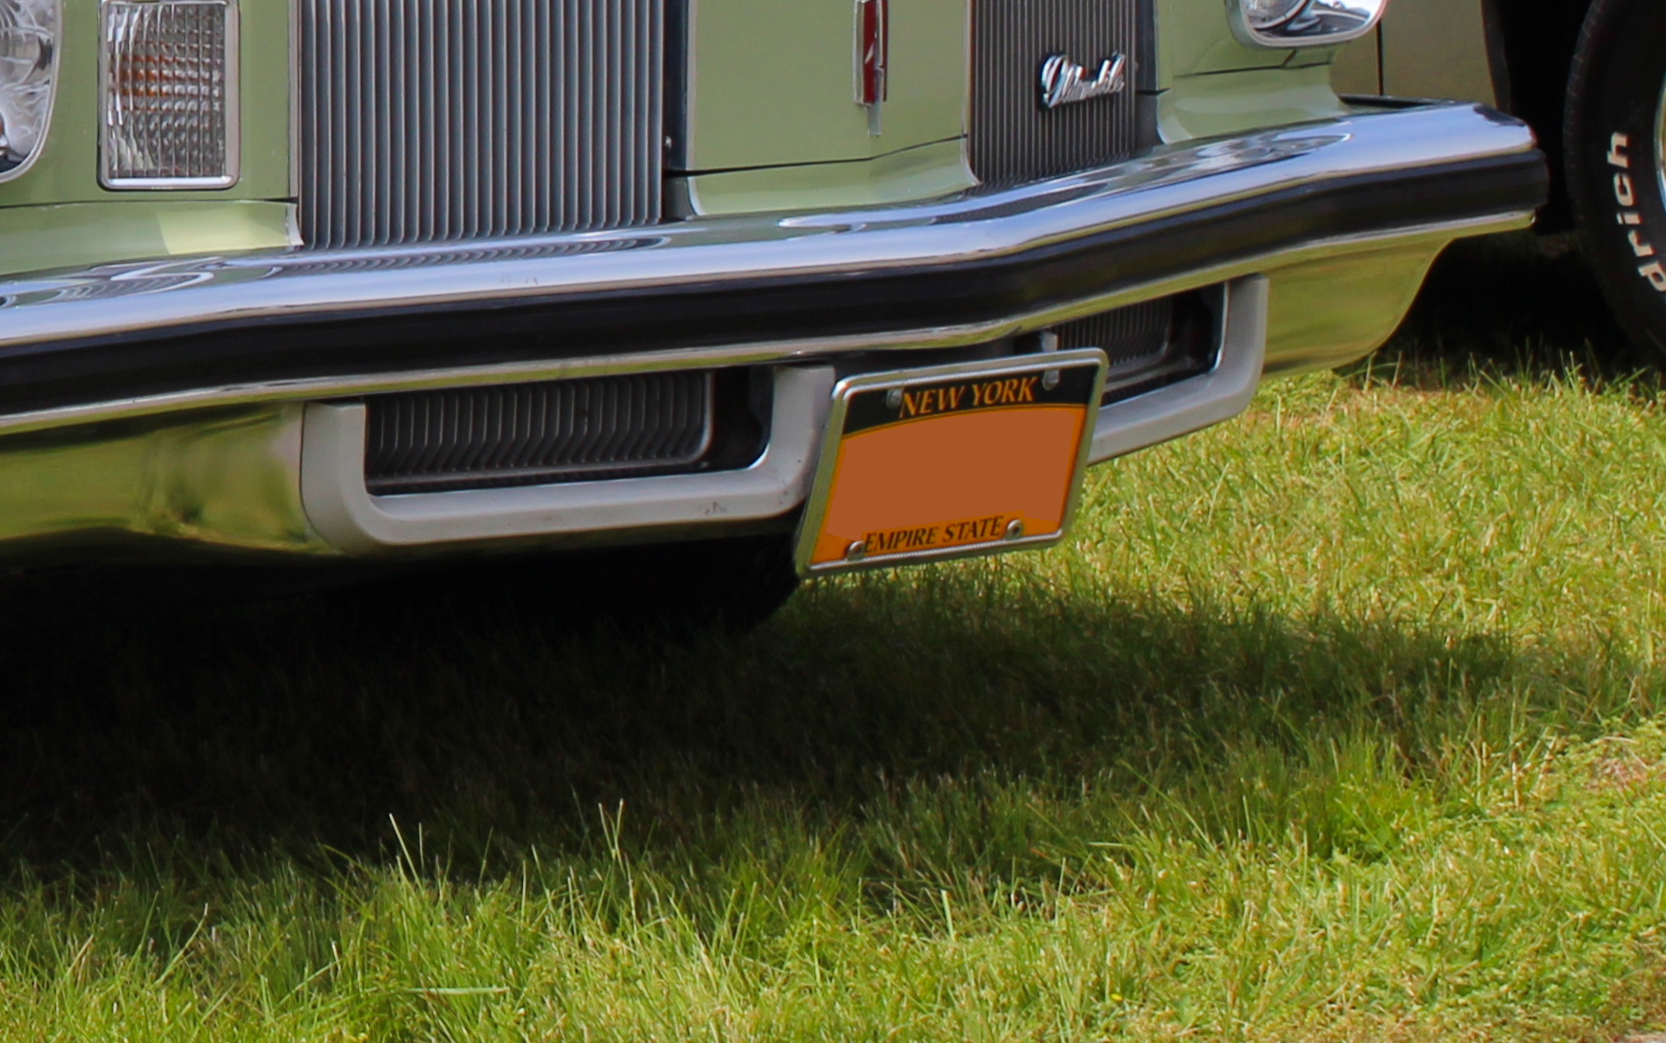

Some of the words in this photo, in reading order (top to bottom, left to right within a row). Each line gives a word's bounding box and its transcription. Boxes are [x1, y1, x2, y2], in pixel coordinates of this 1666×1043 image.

[899, 384, 966, 419] NEW
[971, 376, 1039, 407] YORK
[863, 525, 940, 554] EMPIRE
[942, 515, 1006, 544] STATE
